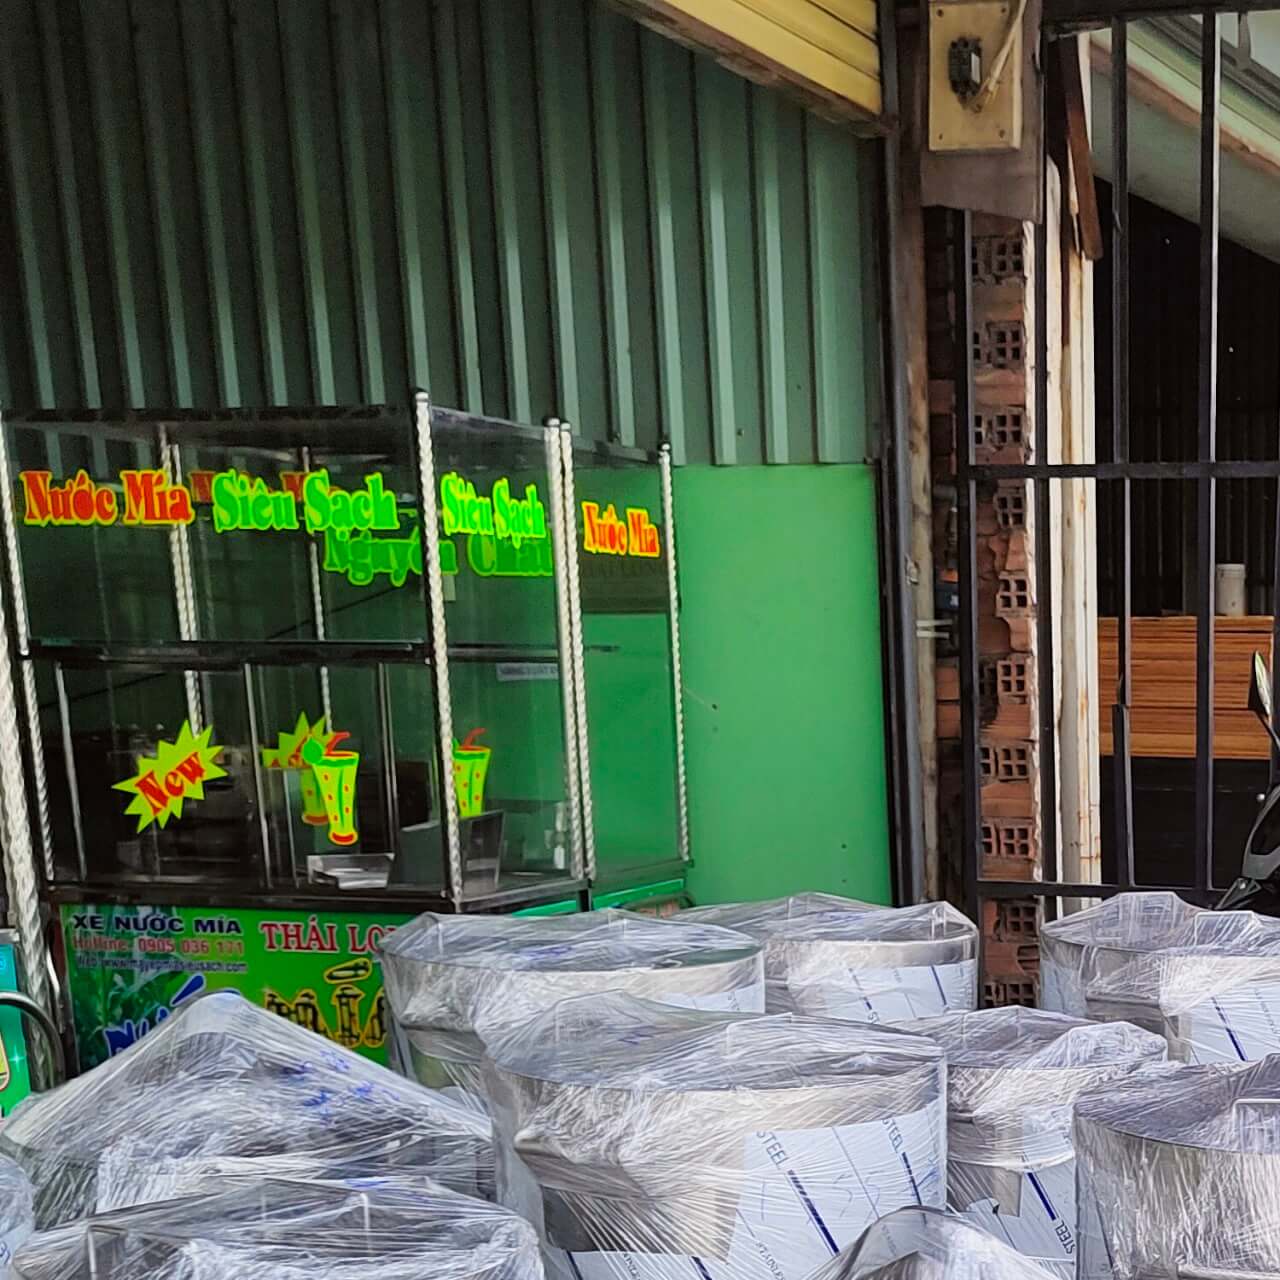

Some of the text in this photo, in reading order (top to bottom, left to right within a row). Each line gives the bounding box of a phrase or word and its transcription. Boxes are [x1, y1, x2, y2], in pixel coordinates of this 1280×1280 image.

[20, 469, 118, 527] Nước
[120, 469, 195, 525] Mía
[212, 468, 299, 533] Siêu
[303, 468, 400, 541] Sạch
[440, 472, 546, 549] Siêu Sạch
[582, 501, 628, 555] Nước
[134, 751, 206, 817] New
[72, 909, 242, 935] XE NƯỚC MÍA
[260, 914, 398, 954] THÁI LO
[756, 1130, 792, 1167] STEEL
[883, 1118, 905, 1154] STEEL
[1054, 1220, 1076, 1255] STEEL
